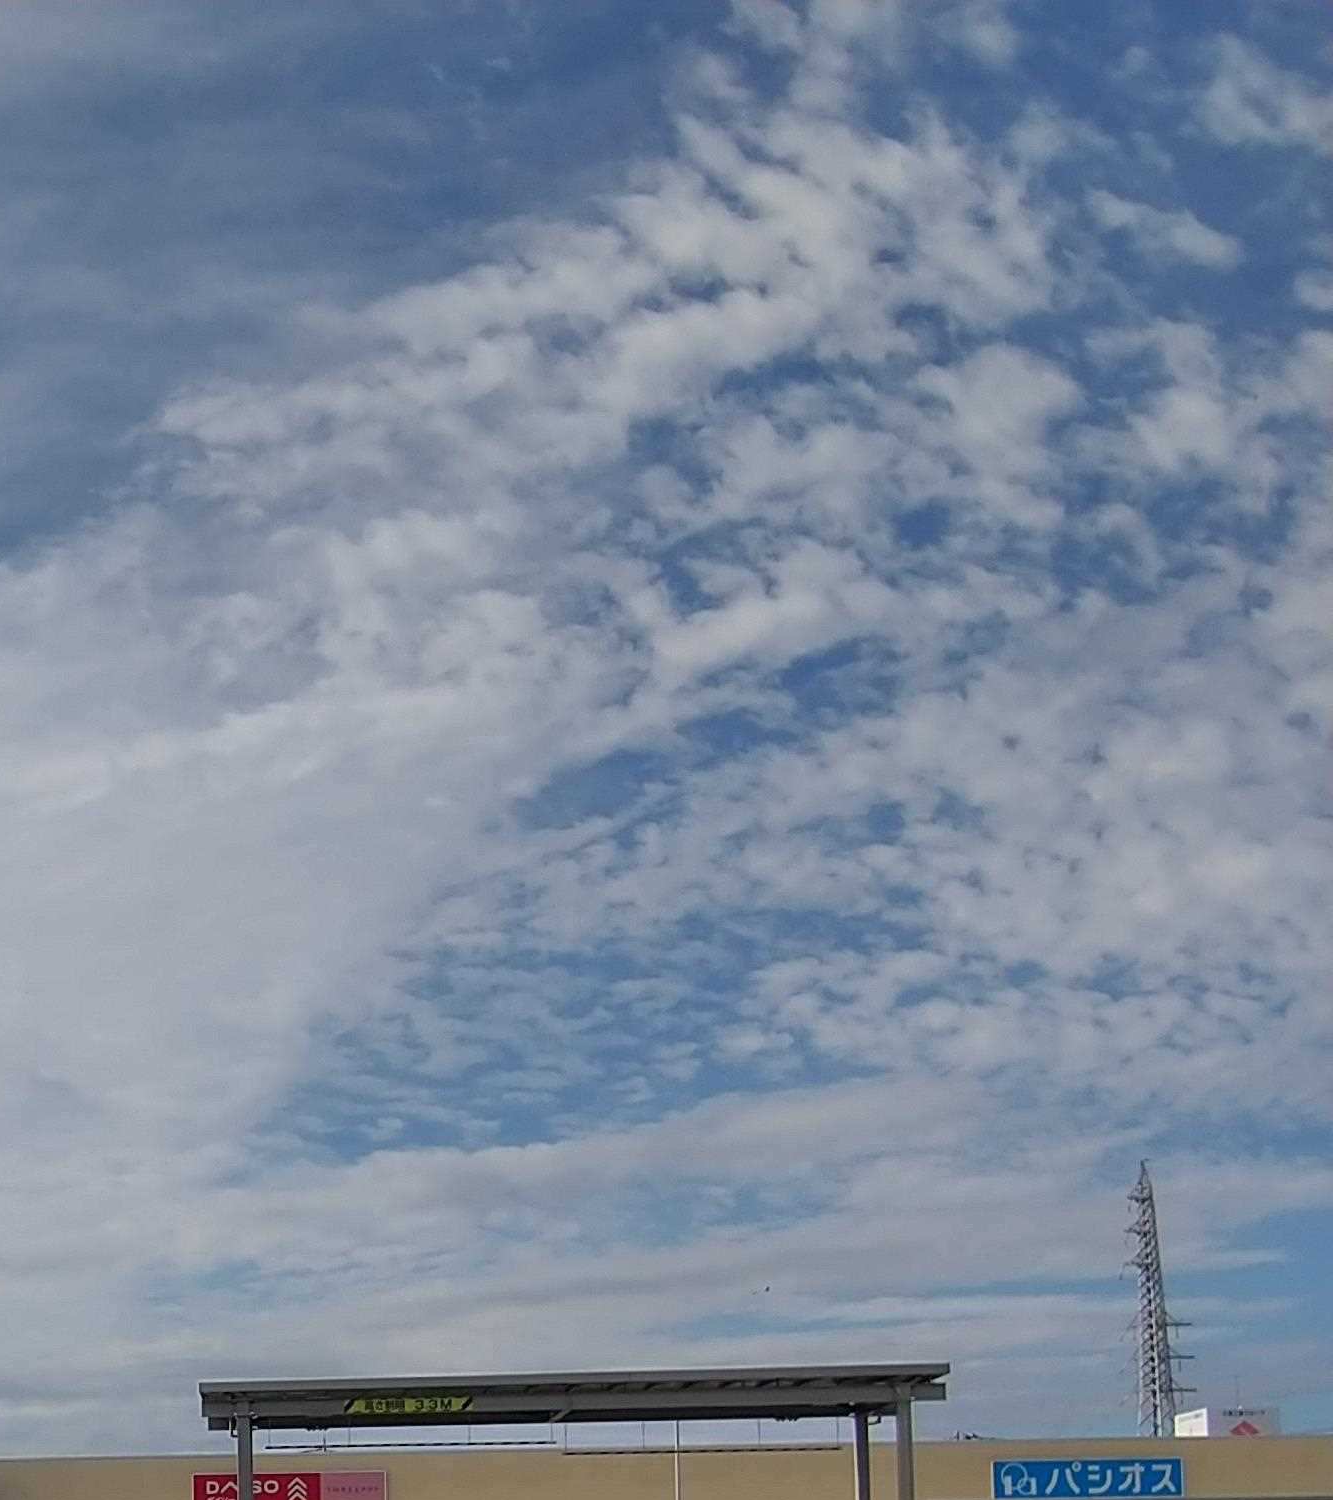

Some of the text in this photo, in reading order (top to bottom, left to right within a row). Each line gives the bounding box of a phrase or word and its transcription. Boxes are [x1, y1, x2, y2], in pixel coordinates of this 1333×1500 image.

[205, 1480, 279, 1494] DASO
[1044, 1461, 1177, 1496] パシオス
